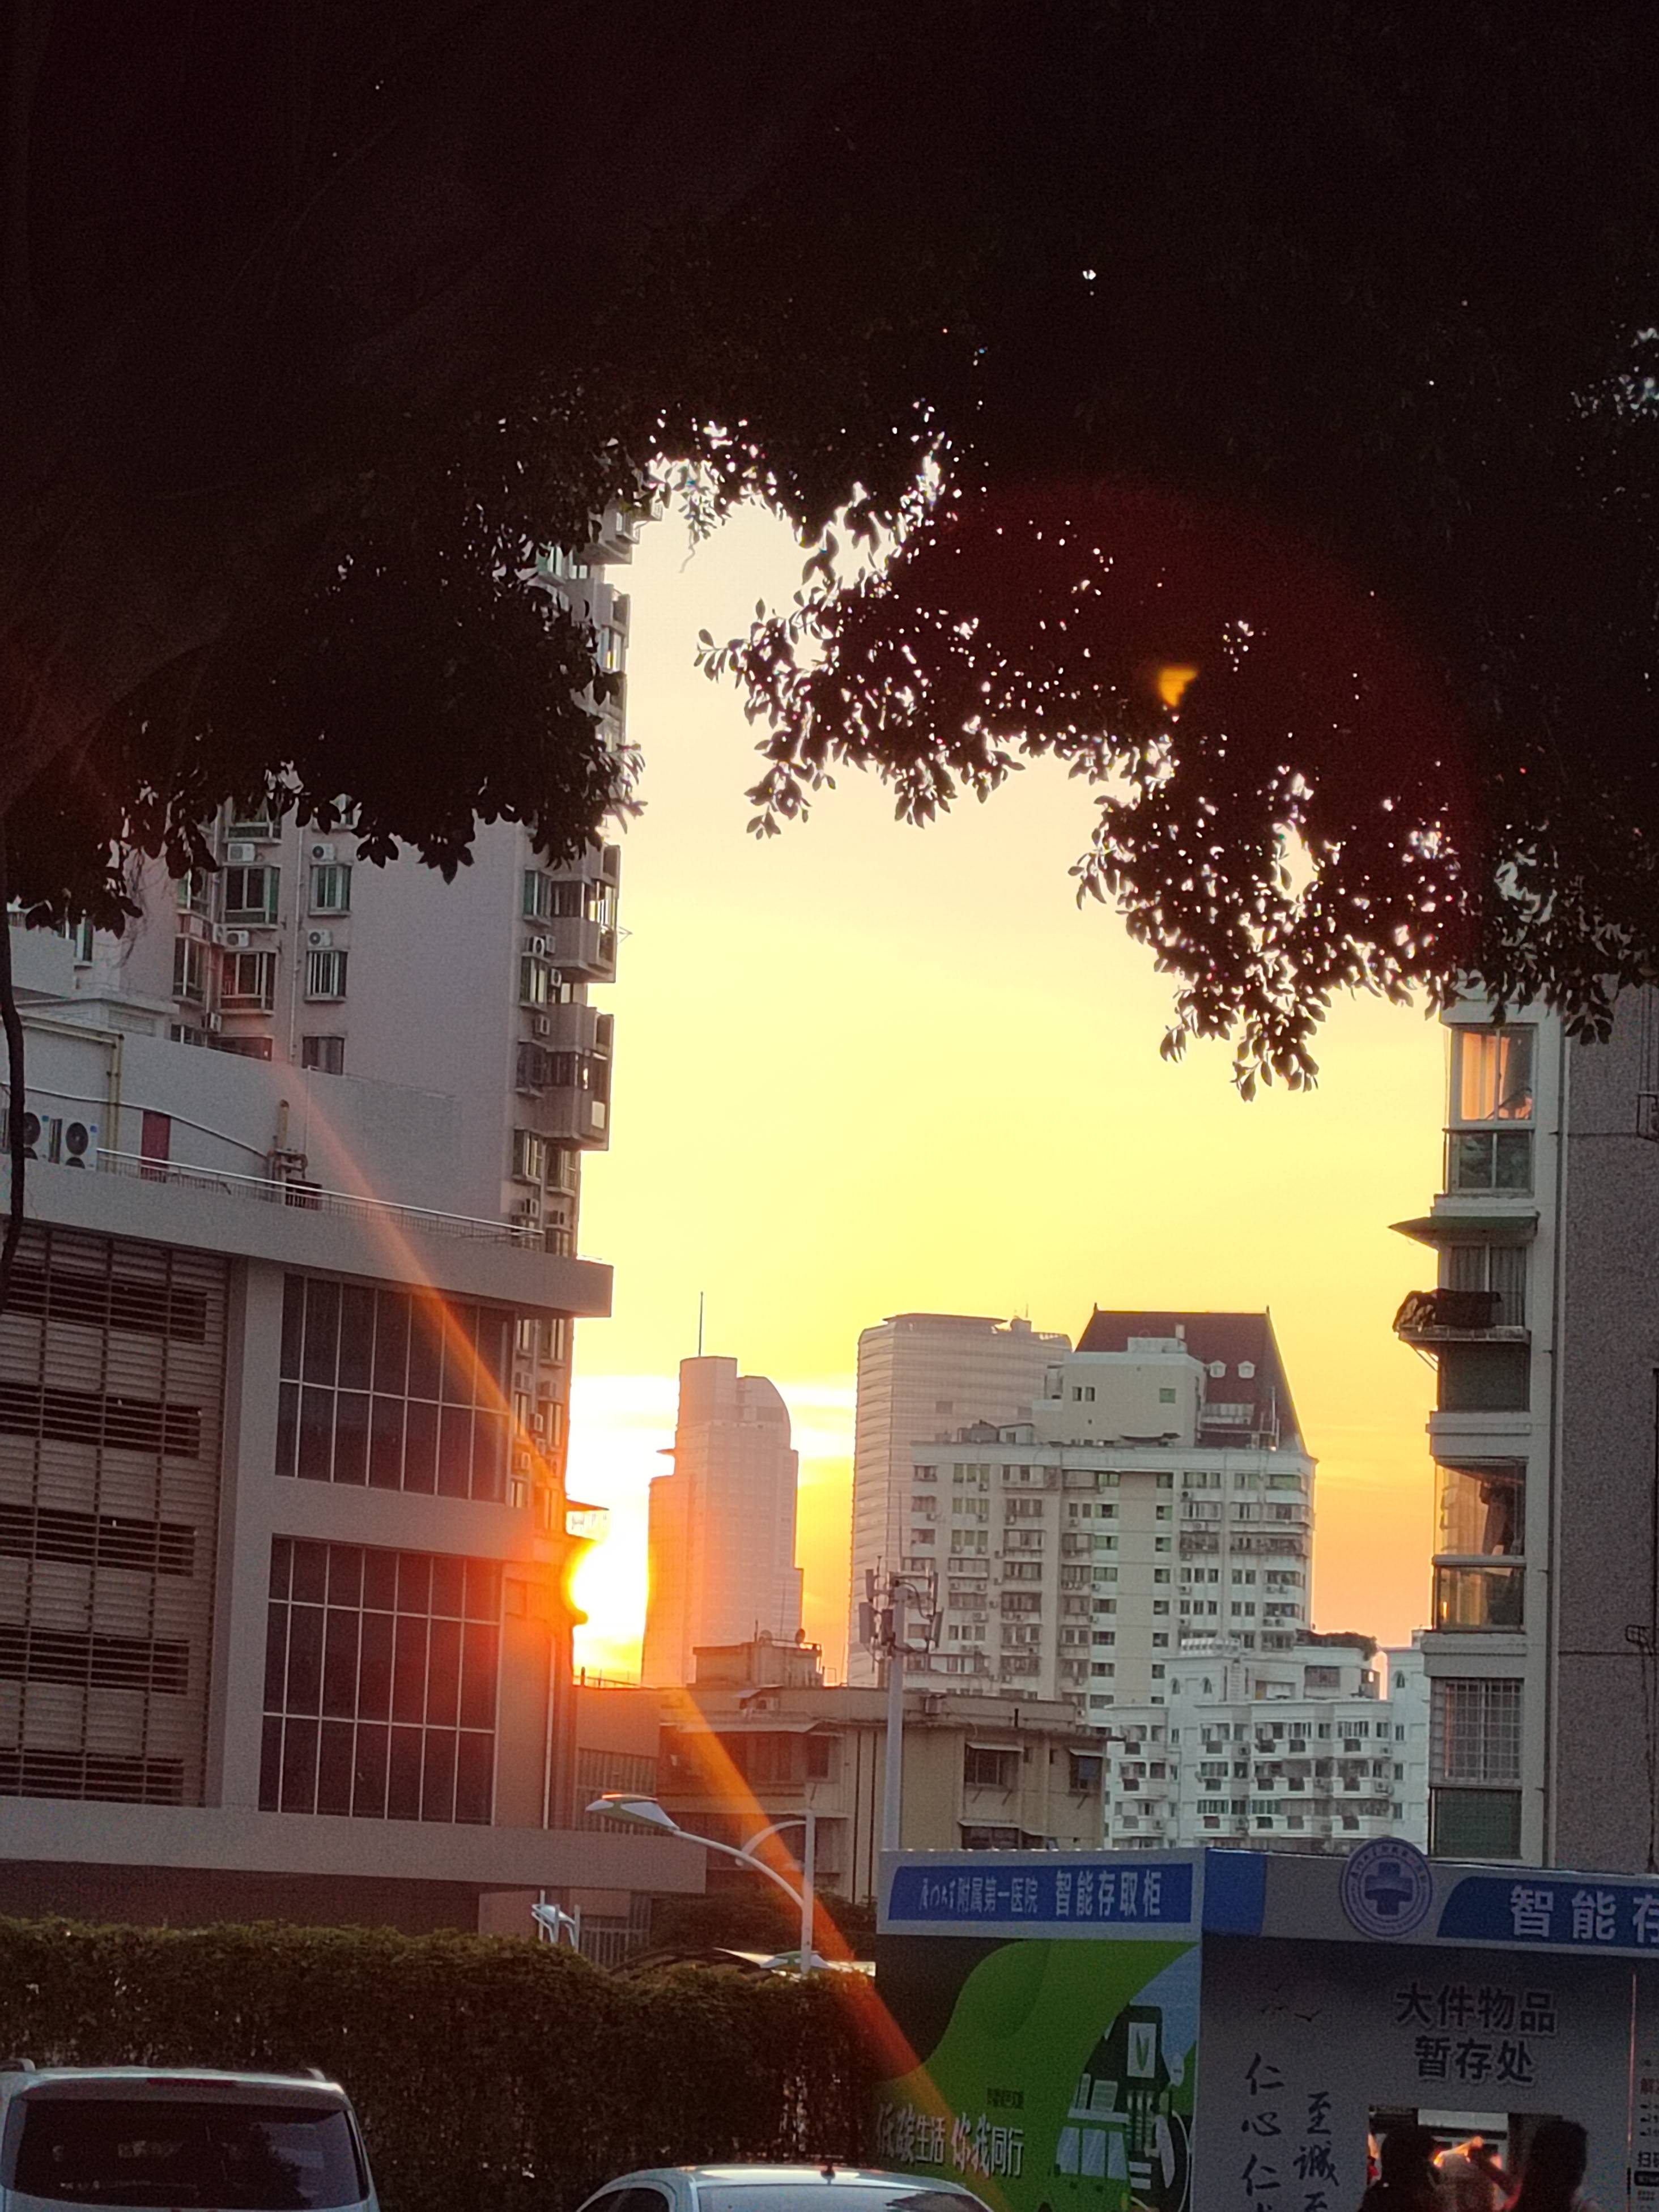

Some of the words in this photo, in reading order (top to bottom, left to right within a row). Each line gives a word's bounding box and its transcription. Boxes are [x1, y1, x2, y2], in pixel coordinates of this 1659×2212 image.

[1056, 1870, 1162, 1916] 智能存取柜
[1510, 1884, 1659, 1944] 智能存
[1396, 1982, 1556, 2034] 大件物品
[1415, 2035, 1535, 2083] 暂存处
